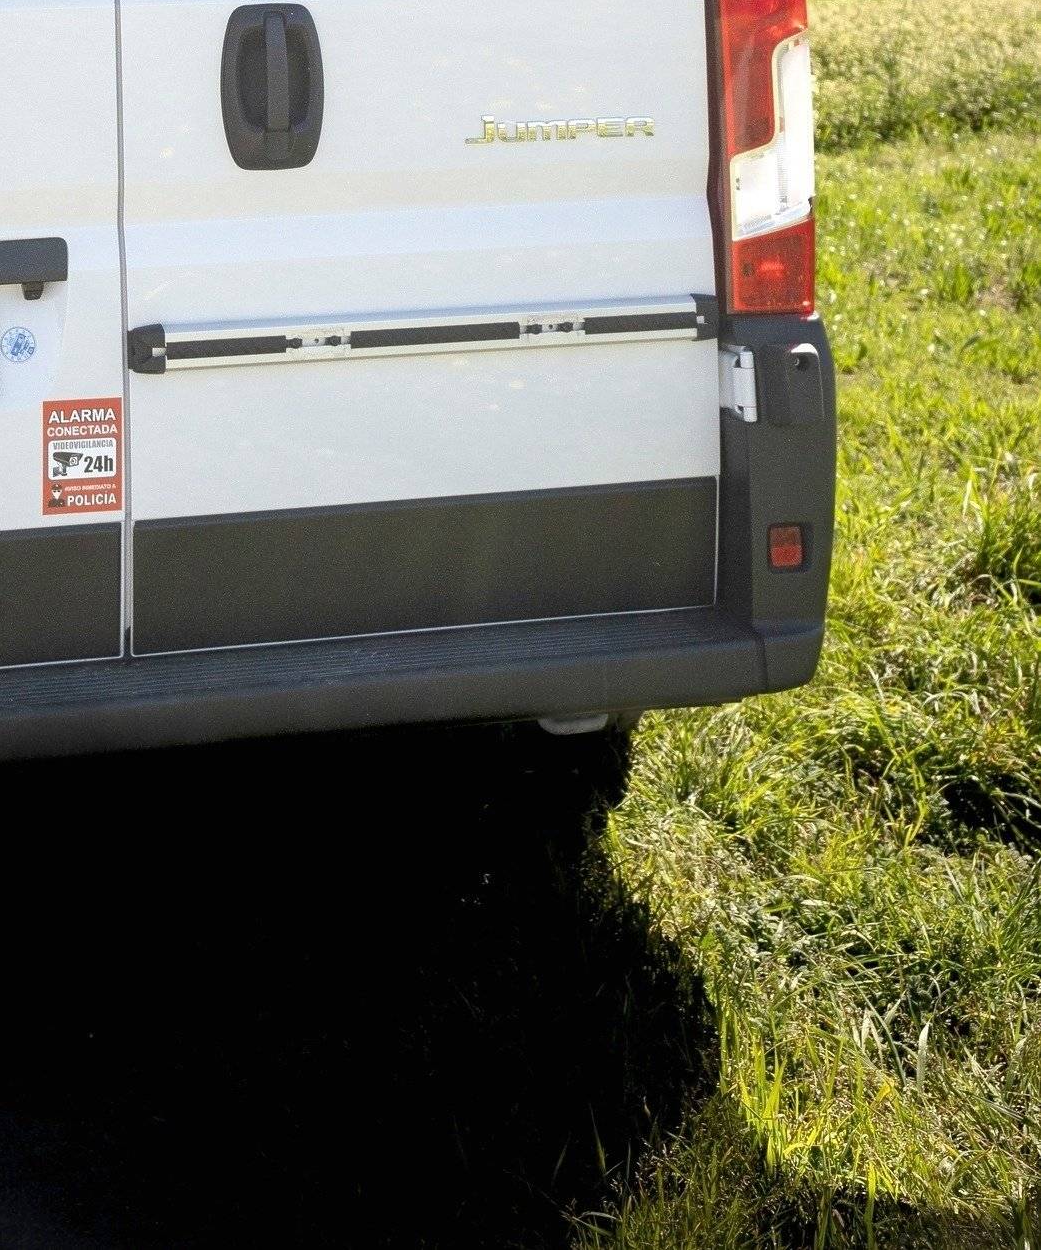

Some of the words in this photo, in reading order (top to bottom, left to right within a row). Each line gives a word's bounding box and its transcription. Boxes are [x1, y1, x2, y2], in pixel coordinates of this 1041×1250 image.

[48, 408, 116, 424] ALARMA
[47, 424, 118, 437] CONECTADA
[52, 440, 114, 450] VIDEOVIGILANCIA
[84, 455, 114, 473] 24h
